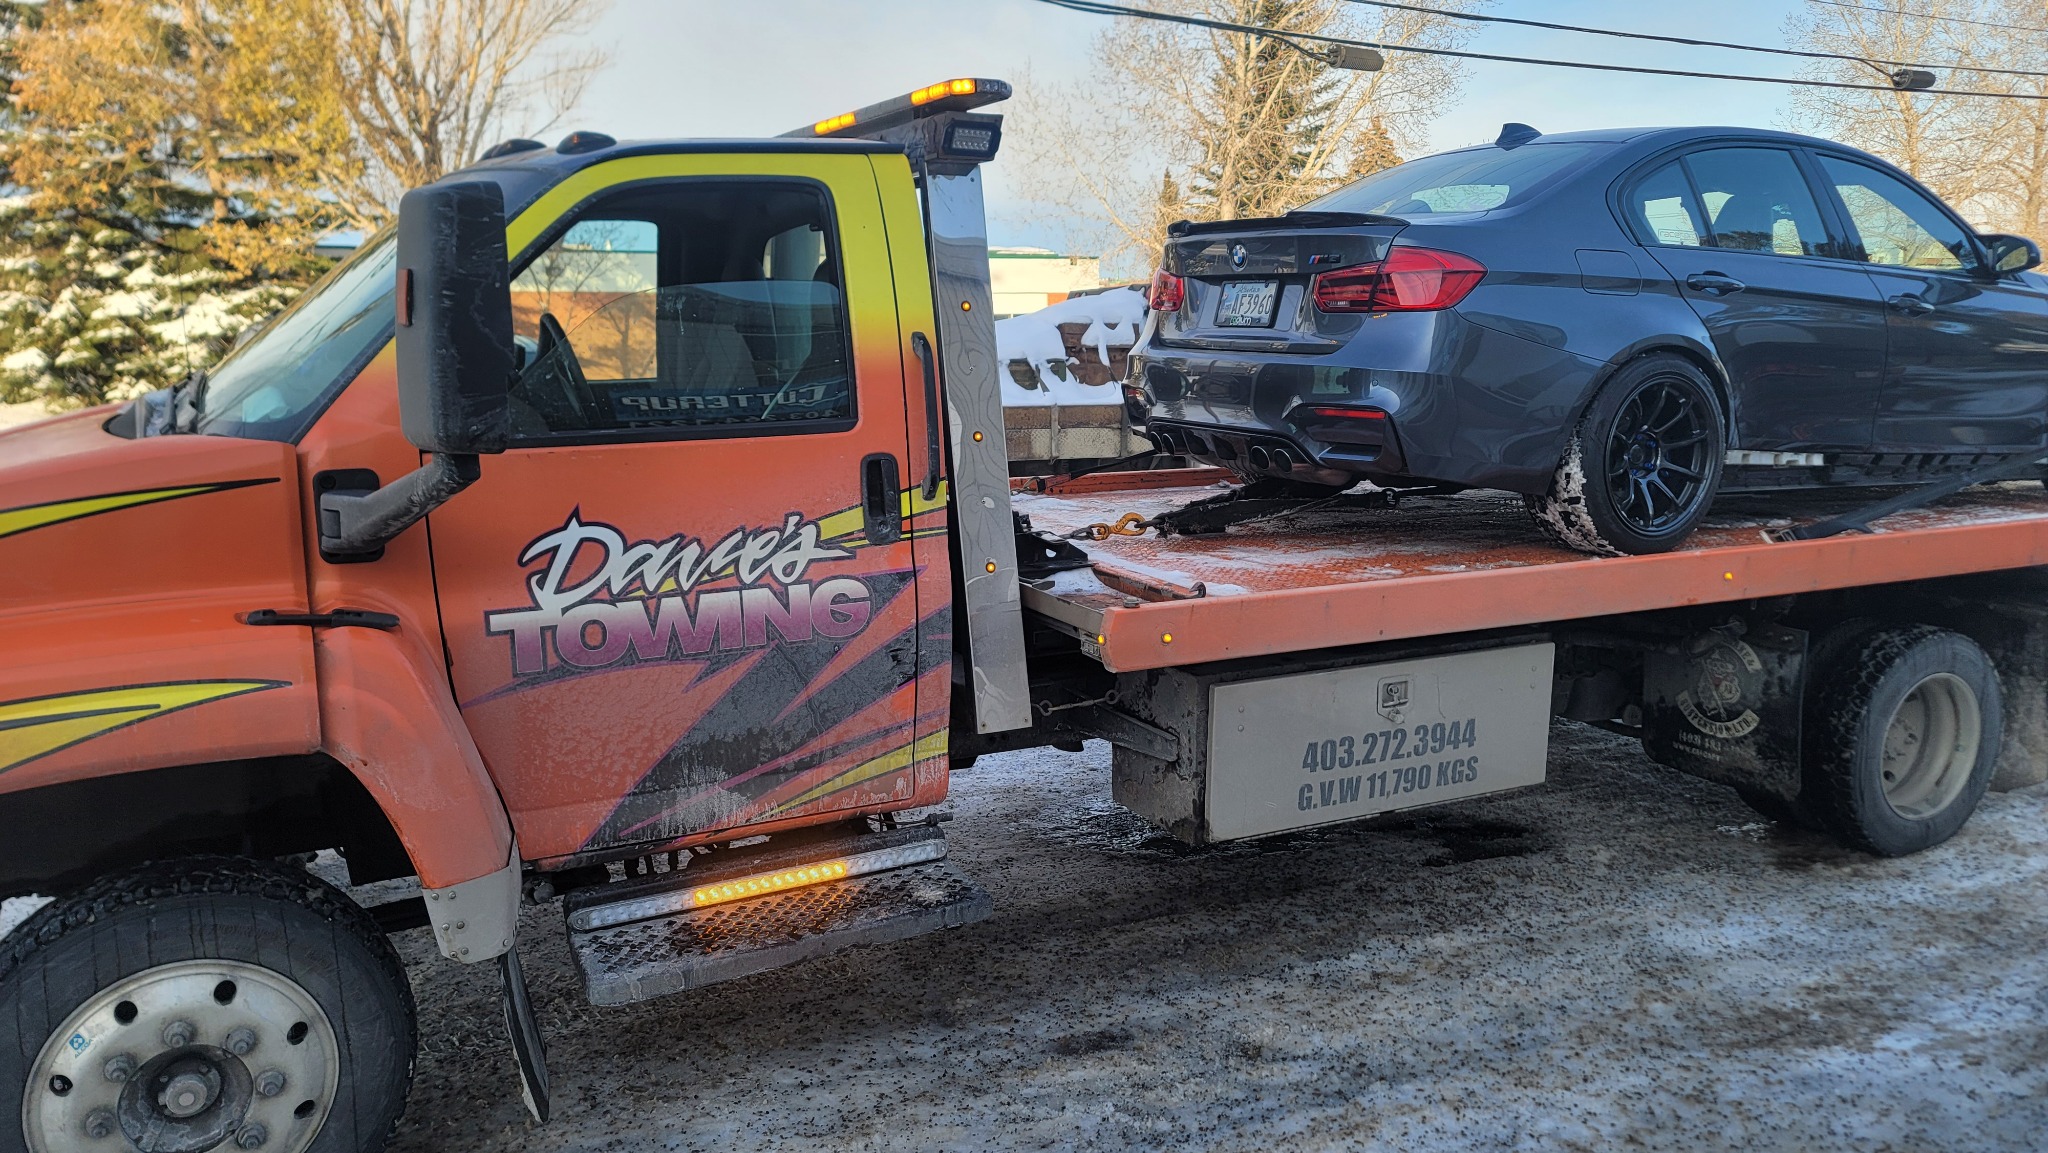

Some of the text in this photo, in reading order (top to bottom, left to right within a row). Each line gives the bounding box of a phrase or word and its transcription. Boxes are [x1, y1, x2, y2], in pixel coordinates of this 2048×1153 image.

[520, 506, 855, 604] Dave's
[488, 577, 872, 674] TOWING
[1298, 755, 1479, 812] G.V.W 11,790 KGS
[1302, 718, 1477, 773] 403.272.3944
